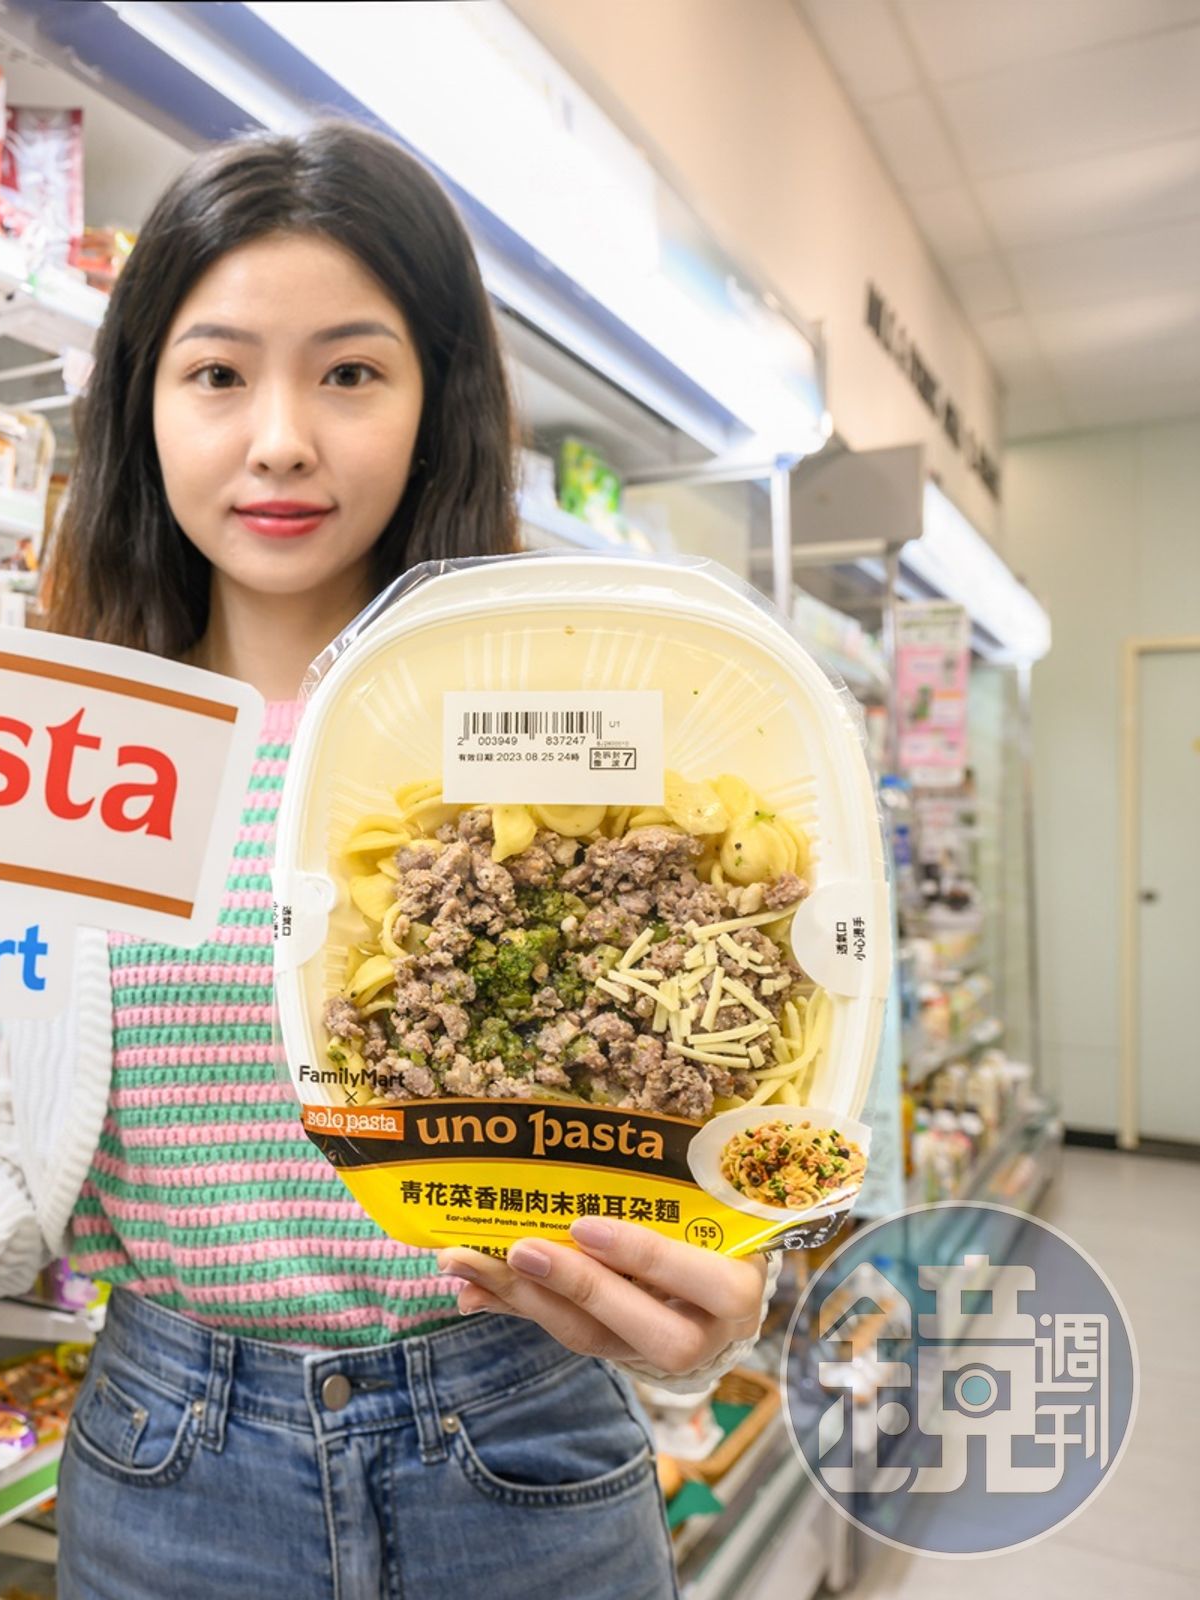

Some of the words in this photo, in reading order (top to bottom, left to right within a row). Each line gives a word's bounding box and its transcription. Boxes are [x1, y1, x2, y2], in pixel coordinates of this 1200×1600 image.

[477, 736, 518, 746] 003949
[545, 736, 586, 746] 837247
[621, 751, 634, 767] 7
[835, 921, 848, 955] 透氣口
[298, 1065, 406, 1088] FamilyMart
[306, 1107, 344, 1129] solo
[346, 1111, 398, 1134] pasta
[416, 1114, 518, 1145] uno
[527, 1109, 664, 1160] pasta
[400, 1180, 680, 1223] 青花菜香腸肉末貓耳朵麵
[446, 1214, 493, 1225] Ear-shaped
[495, 1217, 518, 1226] Pasta
[520, 1219, 538, 1228] with
[694, 1225, 717, 1239] 155
